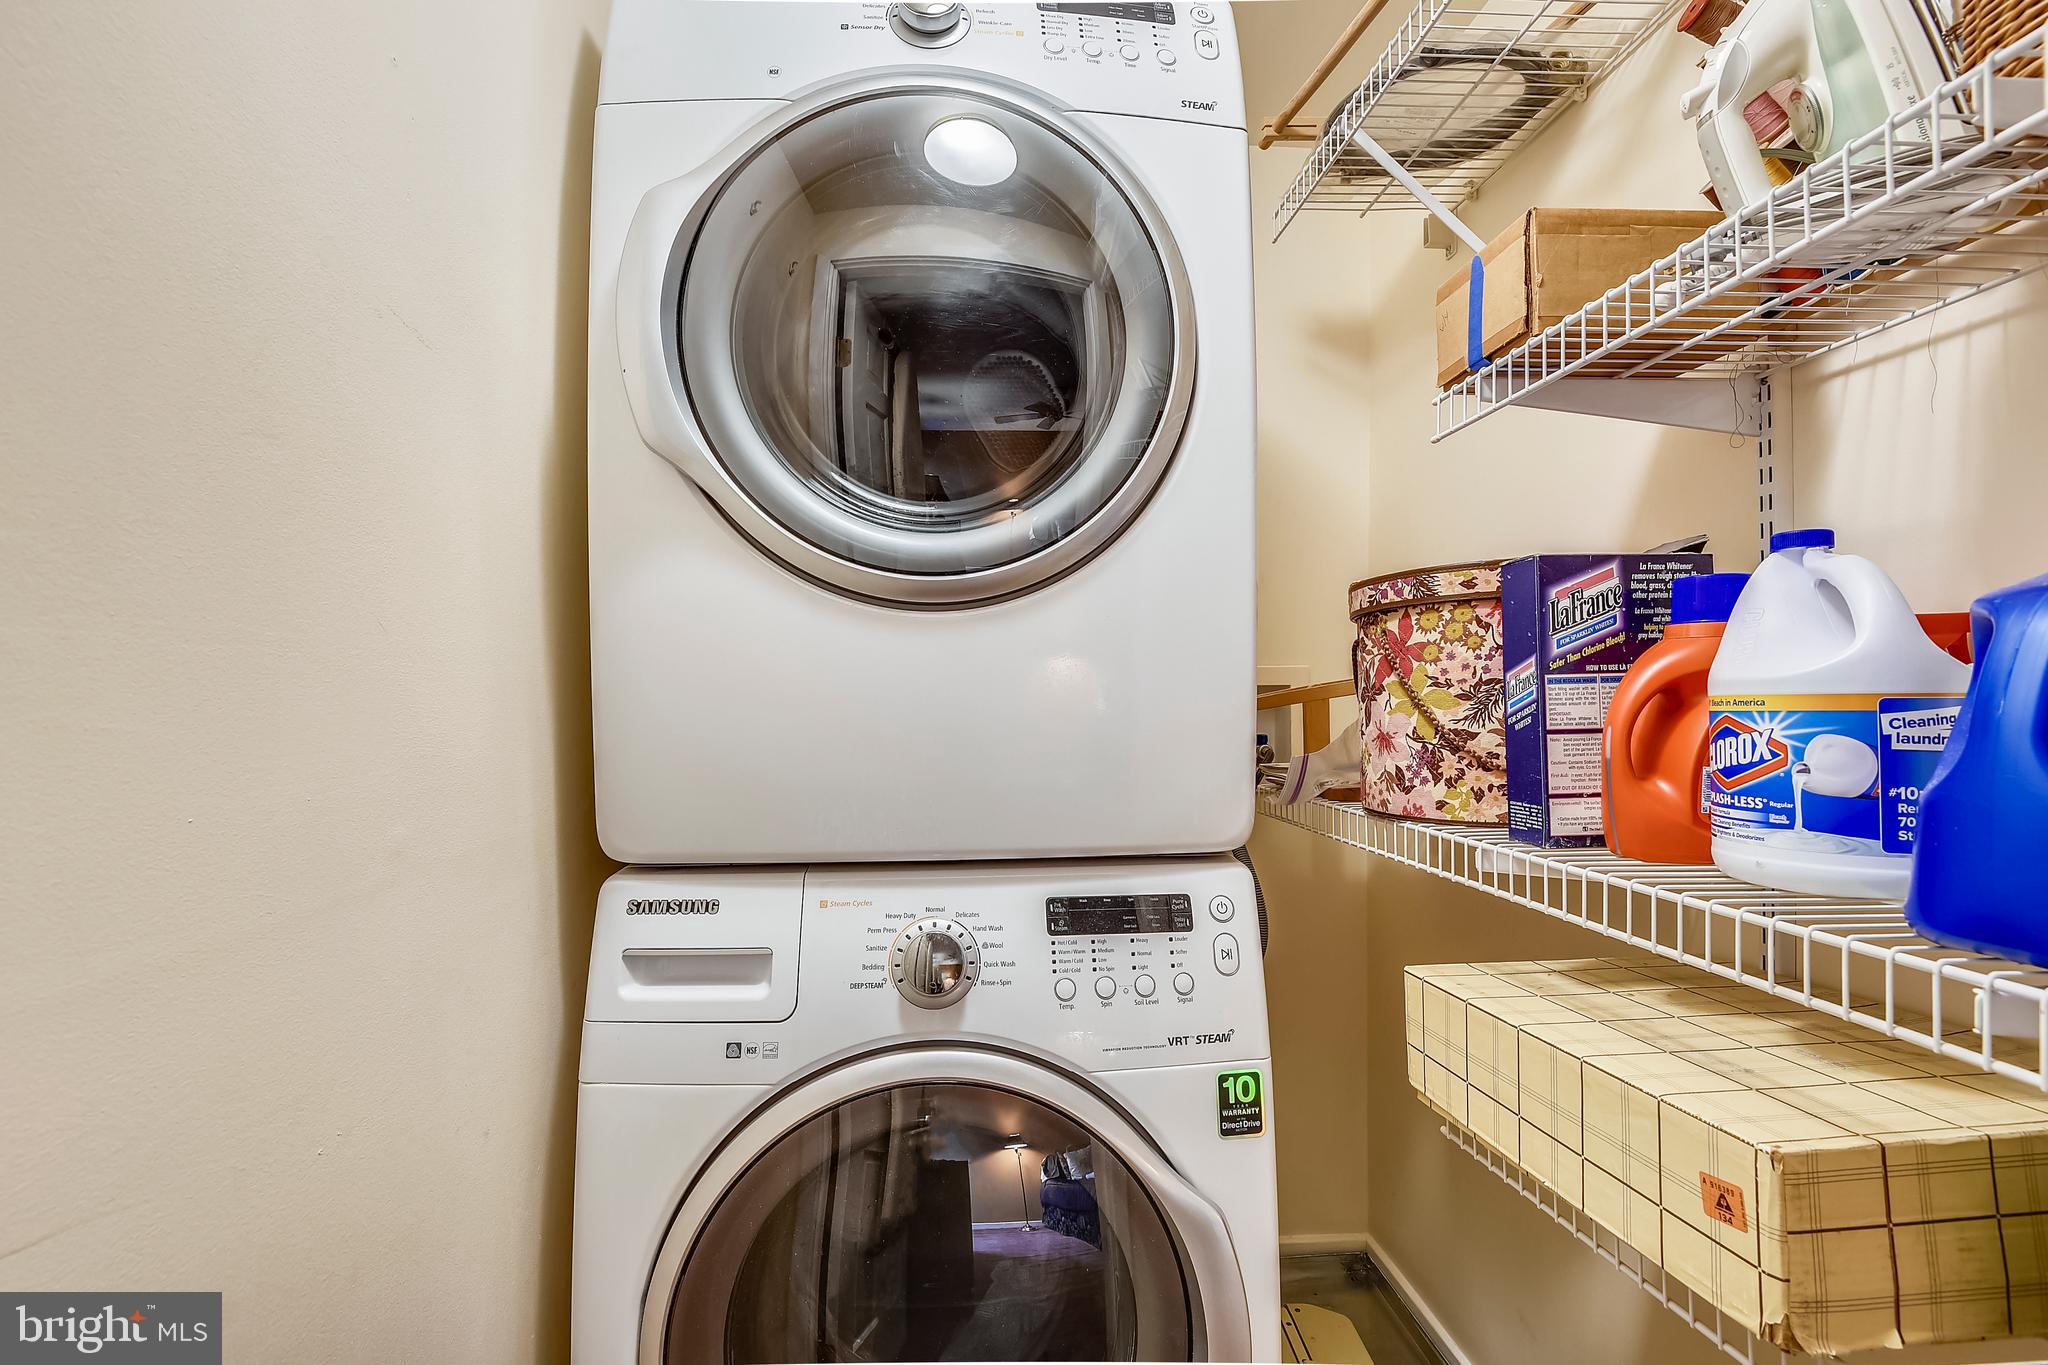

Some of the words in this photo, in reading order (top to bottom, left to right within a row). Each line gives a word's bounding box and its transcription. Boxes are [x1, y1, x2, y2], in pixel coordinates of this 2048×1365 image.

[1181, 99, 1216, 112] STEAM
[1640, 562, 1646, 570] La
[1647, 562, 1665, 570] France
[1656, 572, 1673, 582] tough
[1630, 581, 1648, 590] blood,
[1649, 583, 1666, 591] grass,
[1632, 591, 1647, 599] other
[1648, 591, 1668, 602] protein
[1559, 633, 1571, 647] FOR
[1549, 658, 1566, 672] Safer
[1566, 652, 1582, 666] Than
[1582, 643, 1606, 659] Chlorine
[1606, 631, 1626, 650] Bleach!
[1586, 664, 1599, 672] HOW
[1725, 698, 1731, 706] in
[1732, 699, 1766, 707] America
[1888, 713, 1957, 730] Cleaning
[1895, 732, 1951, 746] laundr
[1769, 801, 1794, 810] Regular
[626, 899, 720, 916] SAMSUNG
[829, 900, 852, 908] Steam
[852, 900, 873, 910] Cycles
[903, 912, 917, 920] Duty
[865, 944, 888, 952] Sanitize
[862, 963, 885, 972] Bedding
[980, 978, 1012, 988] Rinse+Spin
[1100, 1000, 1113, 1010] Spin
[1144, 998, 1160, 1006] Level
[1177, 995, 1194, 1005] Signal
[1195, 1032, 1232, 1046] STEAM
[746, 1046, 758, 1055] NSF
[1222, 1074, 1257, 1105] 10
[1222, 1107, 1261, 1118] WARRANTY
[1222, 1121, 1243, 1131] Direct
[1243, 1119, 1262, 1129] Drive
